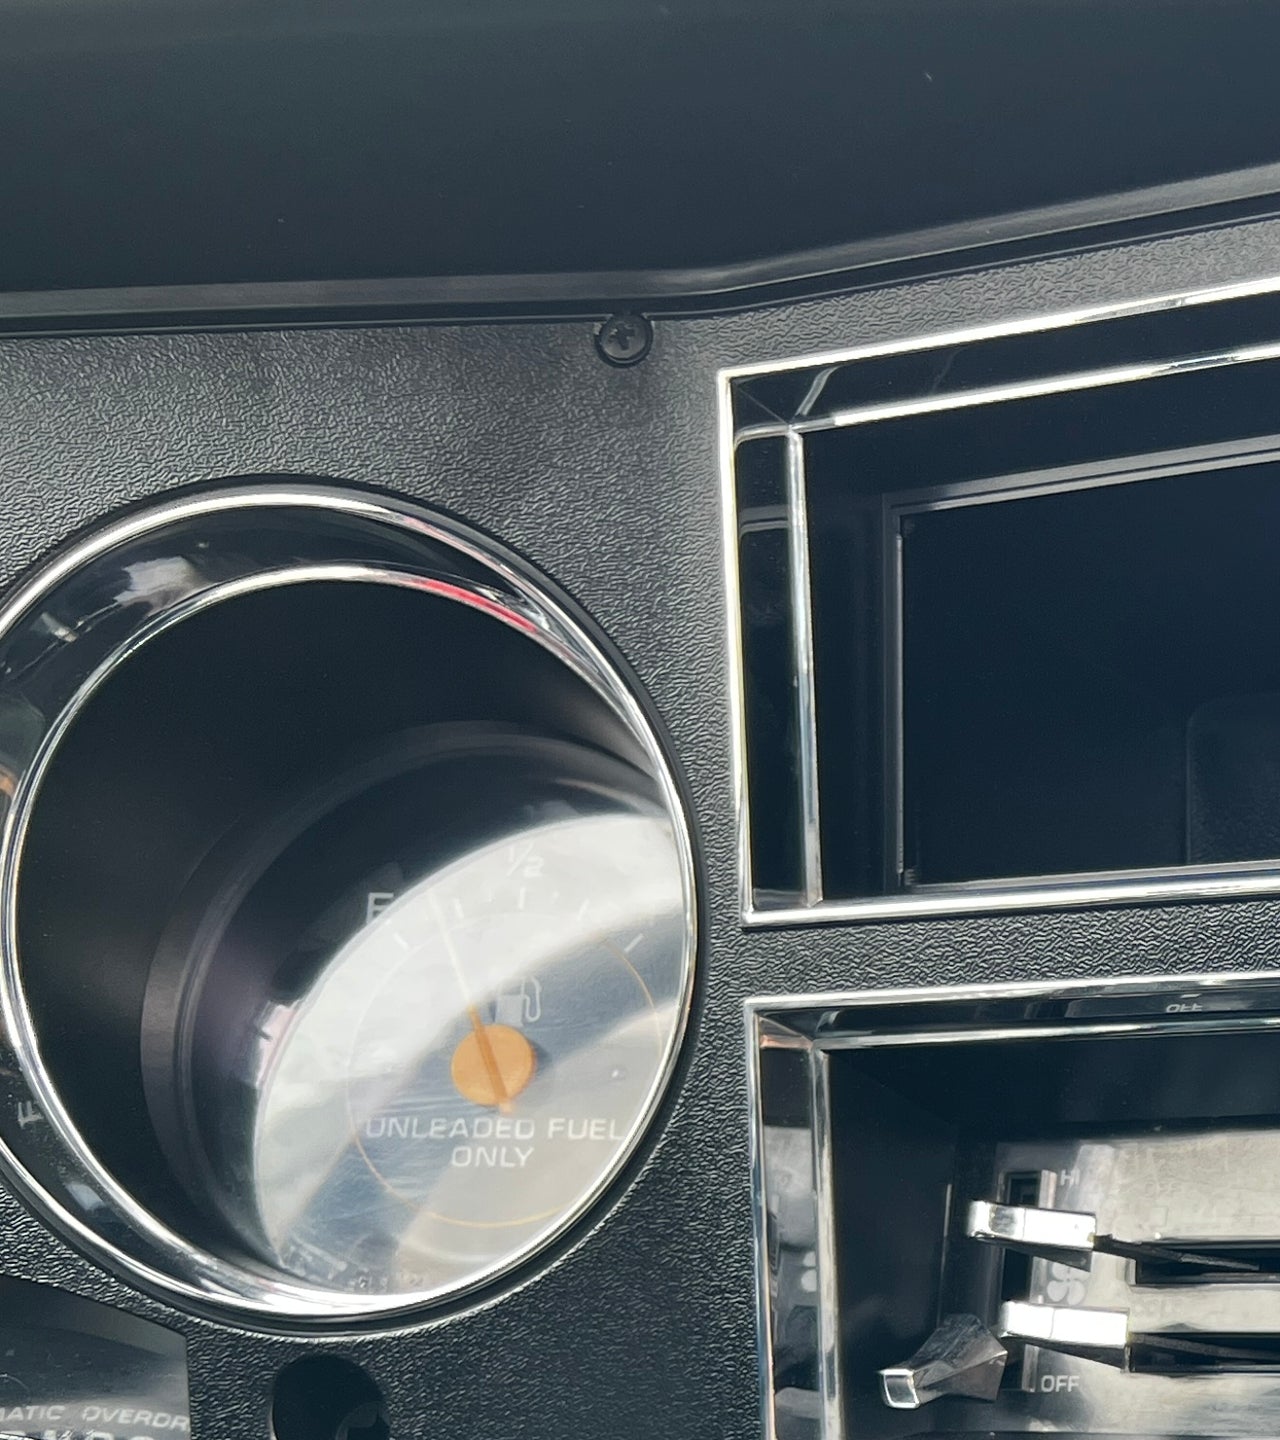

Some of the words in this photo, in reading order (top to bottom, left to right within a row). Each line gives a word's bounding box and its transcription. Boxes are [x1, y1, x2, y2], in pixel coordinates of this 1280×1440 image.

[366, 1116, 536, 1139] UNLEADED
[547, 1117, 626, 1140] FUEL
[451, 1146, 535, 1167] ONLY
[1060, 1170, 1081, 1187] HI
[1041, 1375, 1081, 1393] OFF
[0, 1405, 65, 1421] ATIC
